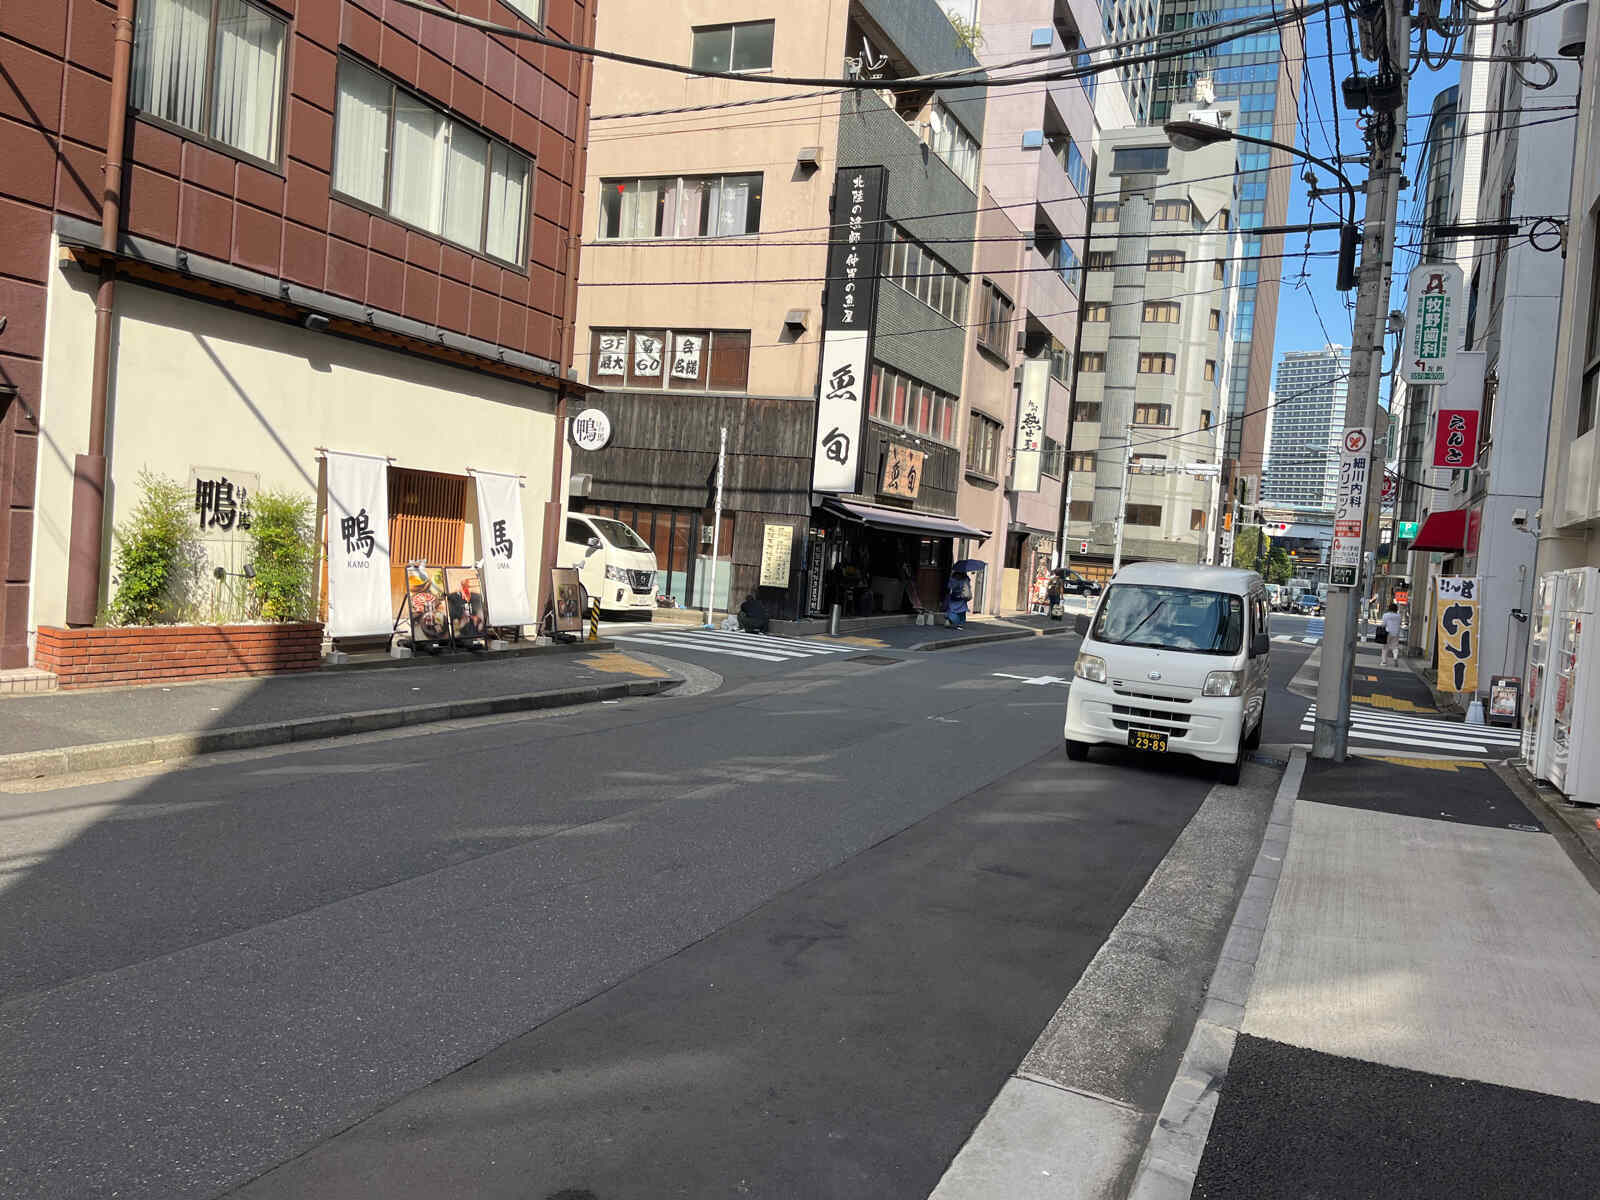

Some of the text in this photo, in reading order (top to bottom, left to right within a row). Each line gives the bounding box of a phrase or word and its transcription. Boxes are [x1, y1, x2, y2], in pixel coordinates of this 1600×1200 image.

[601, 338, 626, 350] 3F
[1421, 297, 1443, 358] 牧野歯科
[576, 417, 597, 442] 鴨
[822, 363, 857, 466] 魚旬
[195, 476, 237, 531] 鴨
[1337, 462, 1352, 519] クリニック
[1350, 457, 1366, 508] 細川内科
[340, 507, 376, 560] 鴨
[490, 519, 514, 560] 馬
[347, 561, 370, 570] KAMO
[1136, 737, 1166, 752] 29-89
